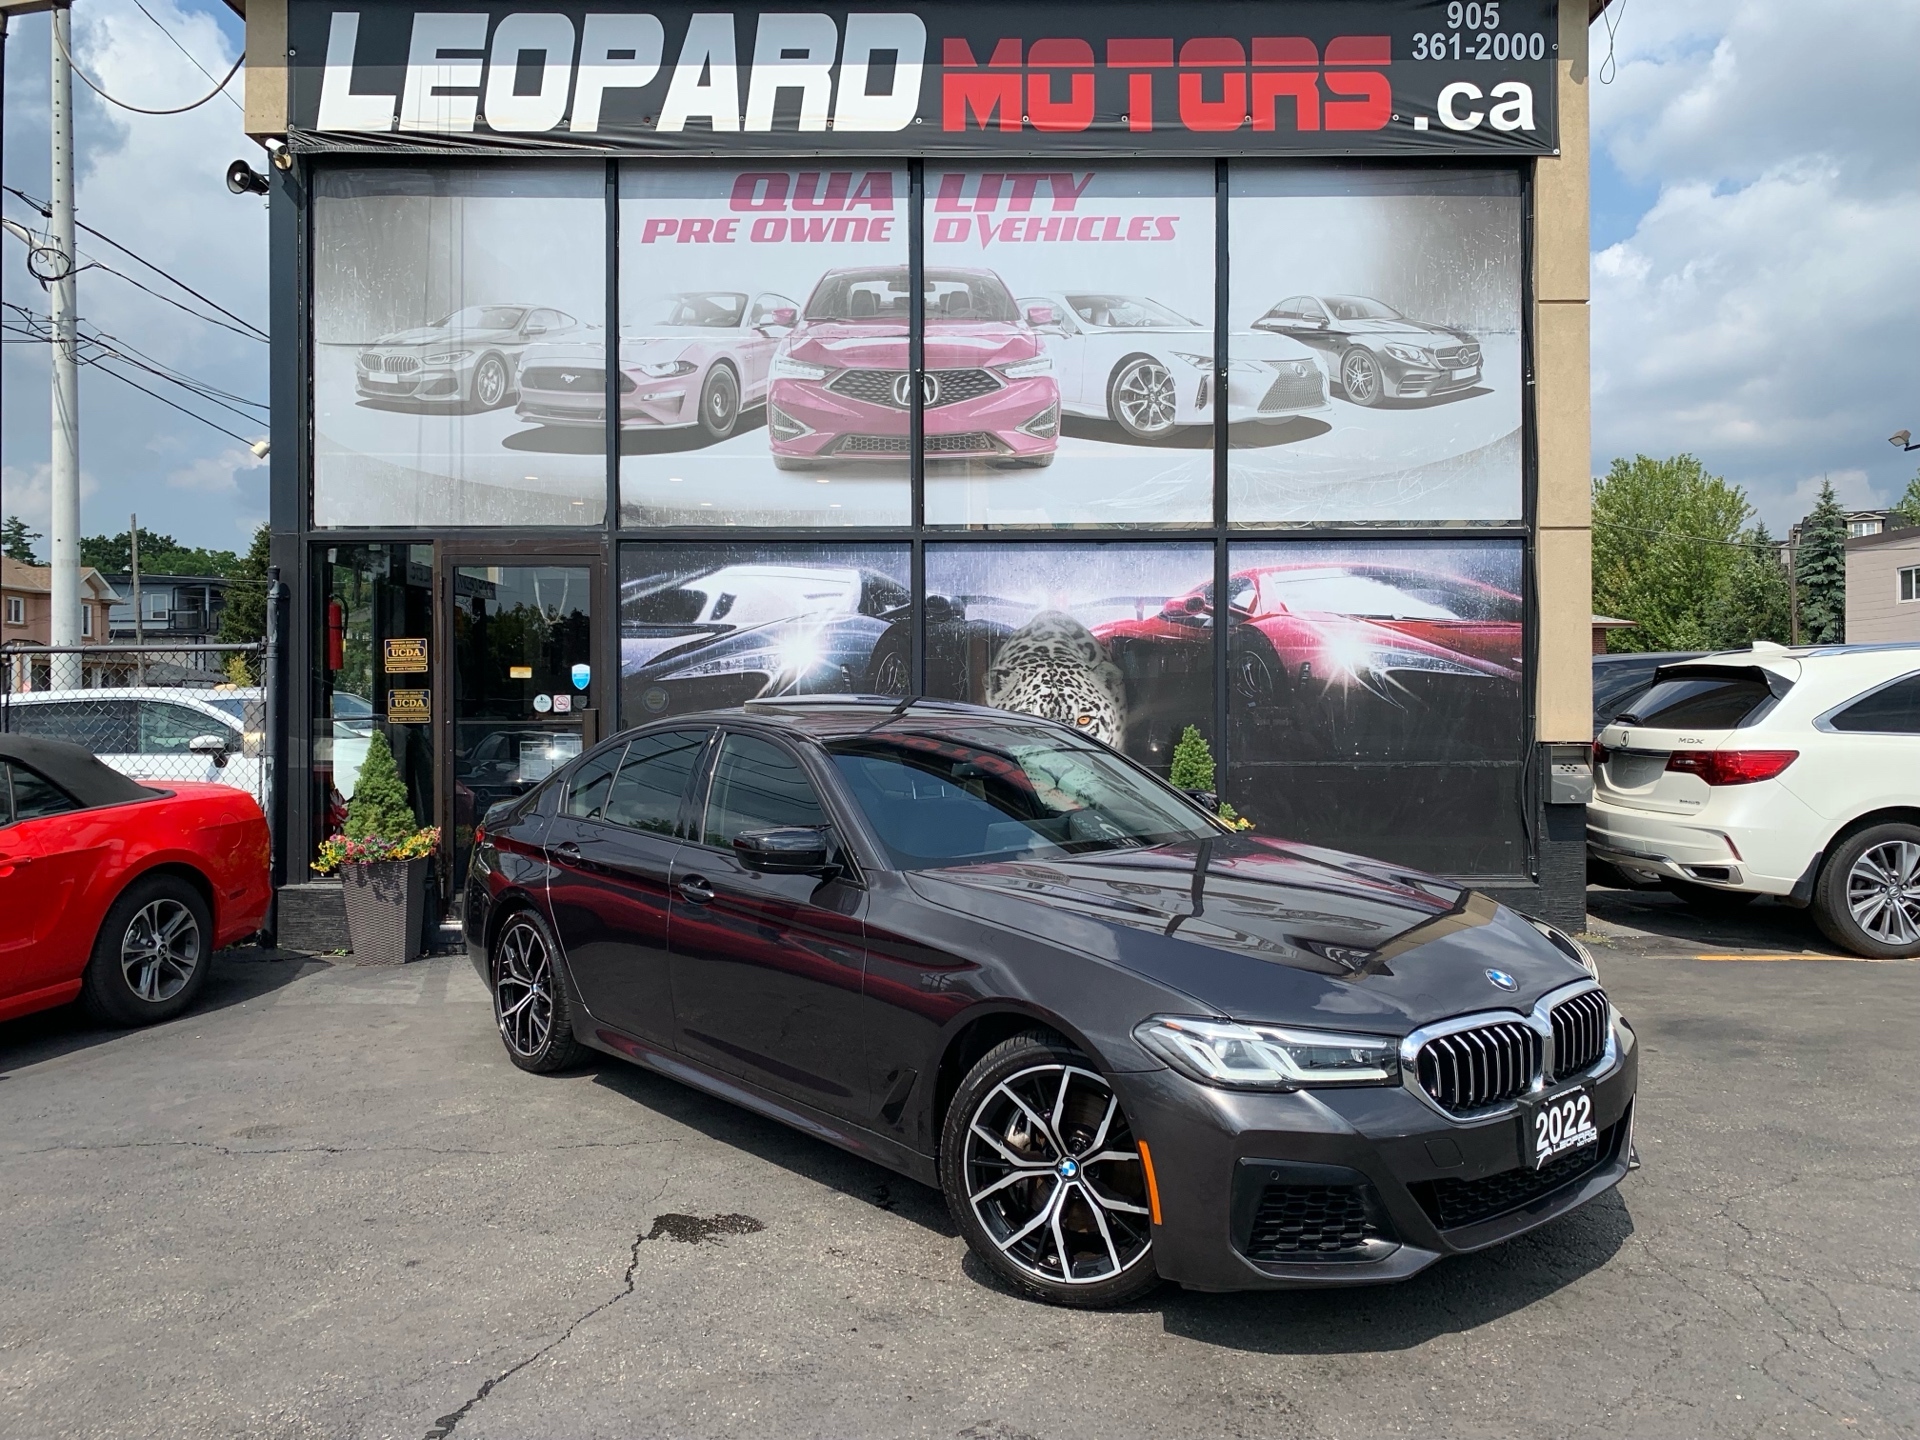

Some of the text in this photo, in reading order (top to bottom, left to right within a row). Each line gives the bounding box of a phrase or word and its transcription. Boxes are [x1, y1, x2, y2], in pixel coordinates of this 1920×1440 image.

[1447, 1, 1499, 29] 905
[1412, 33, 1545, 60] 361-2000
[317, 12, 1536, 132] LEOPARD MOTORS .ca
[729, 172, 1096, 212] QUA LITY
[641, 218, 741, 243] PRE
[750, 217, 895, 243] OWNE
[391, 648, 421, 657] UCDA
[394, 699, 425, 708] UCDA
[1536, 1094, 1591, 1152] 2022
[1553, 1126, 1597, 1152] LEOPARD
